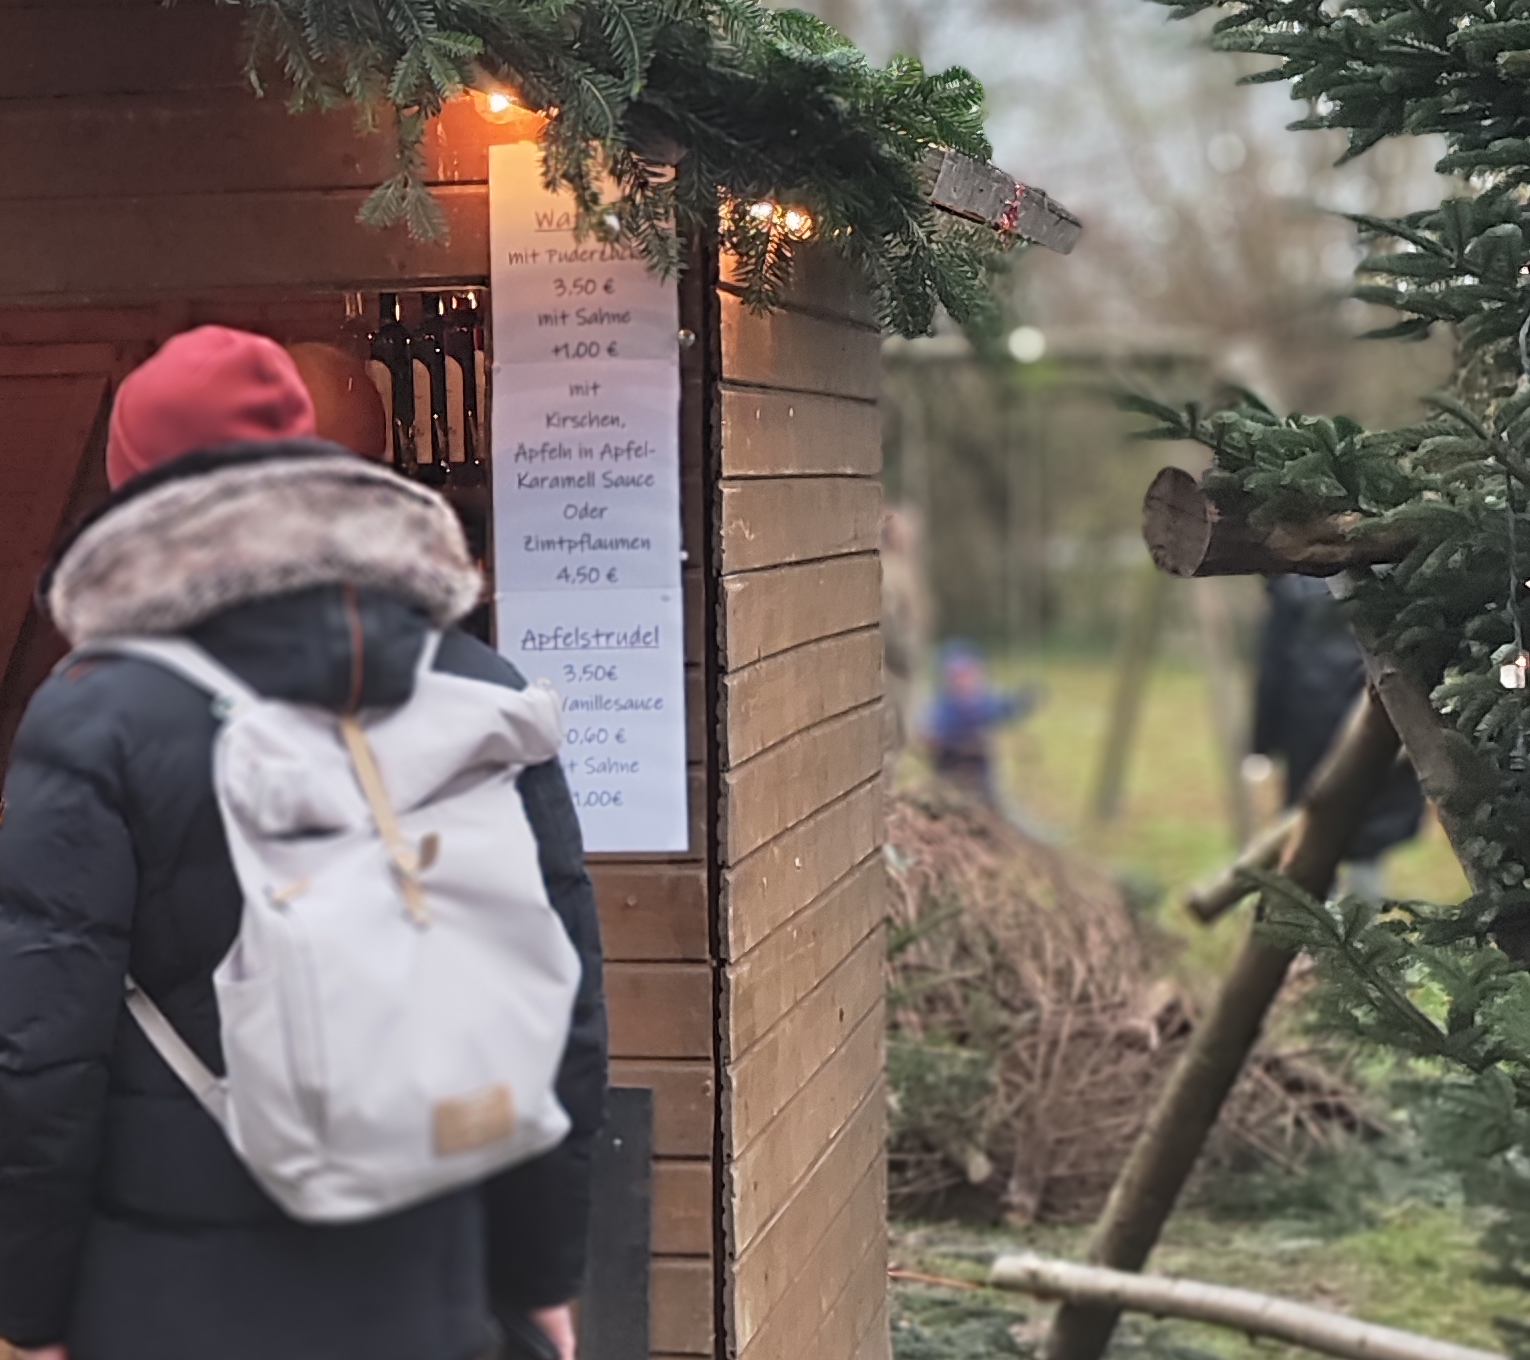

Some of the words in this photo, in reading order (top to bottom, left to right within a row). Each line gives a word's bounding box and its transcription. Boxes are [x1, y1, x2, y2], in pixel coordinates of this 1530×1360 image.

[509, 248, 538, 265] mit
[553, 278, 598, 296] 3,50
[603, 278, 616, 295] €
[538, 312, 568, 327] mit
[575, 308, 633, 326] Sahne
[606, 341, 620, 357] €
[569, 381, 600, 397] mit
[545, 409, 627, 429] Kirschen,
[577, 442, 595, 460] in
[600, 439, 656, 462] Apfel-
[517, 470, 596, 489] Karamell
[601, 470, 655, 488] Sauce
[562, 501, 609, 520] Oder
[556, 566, 600, 584] 4,50
[606, 567, 619, 584] €
[521, 624, 659, 651] Apfelstrudel
[615, 727, 628, 744] €
[584, 756, 641, 775] Sahne
